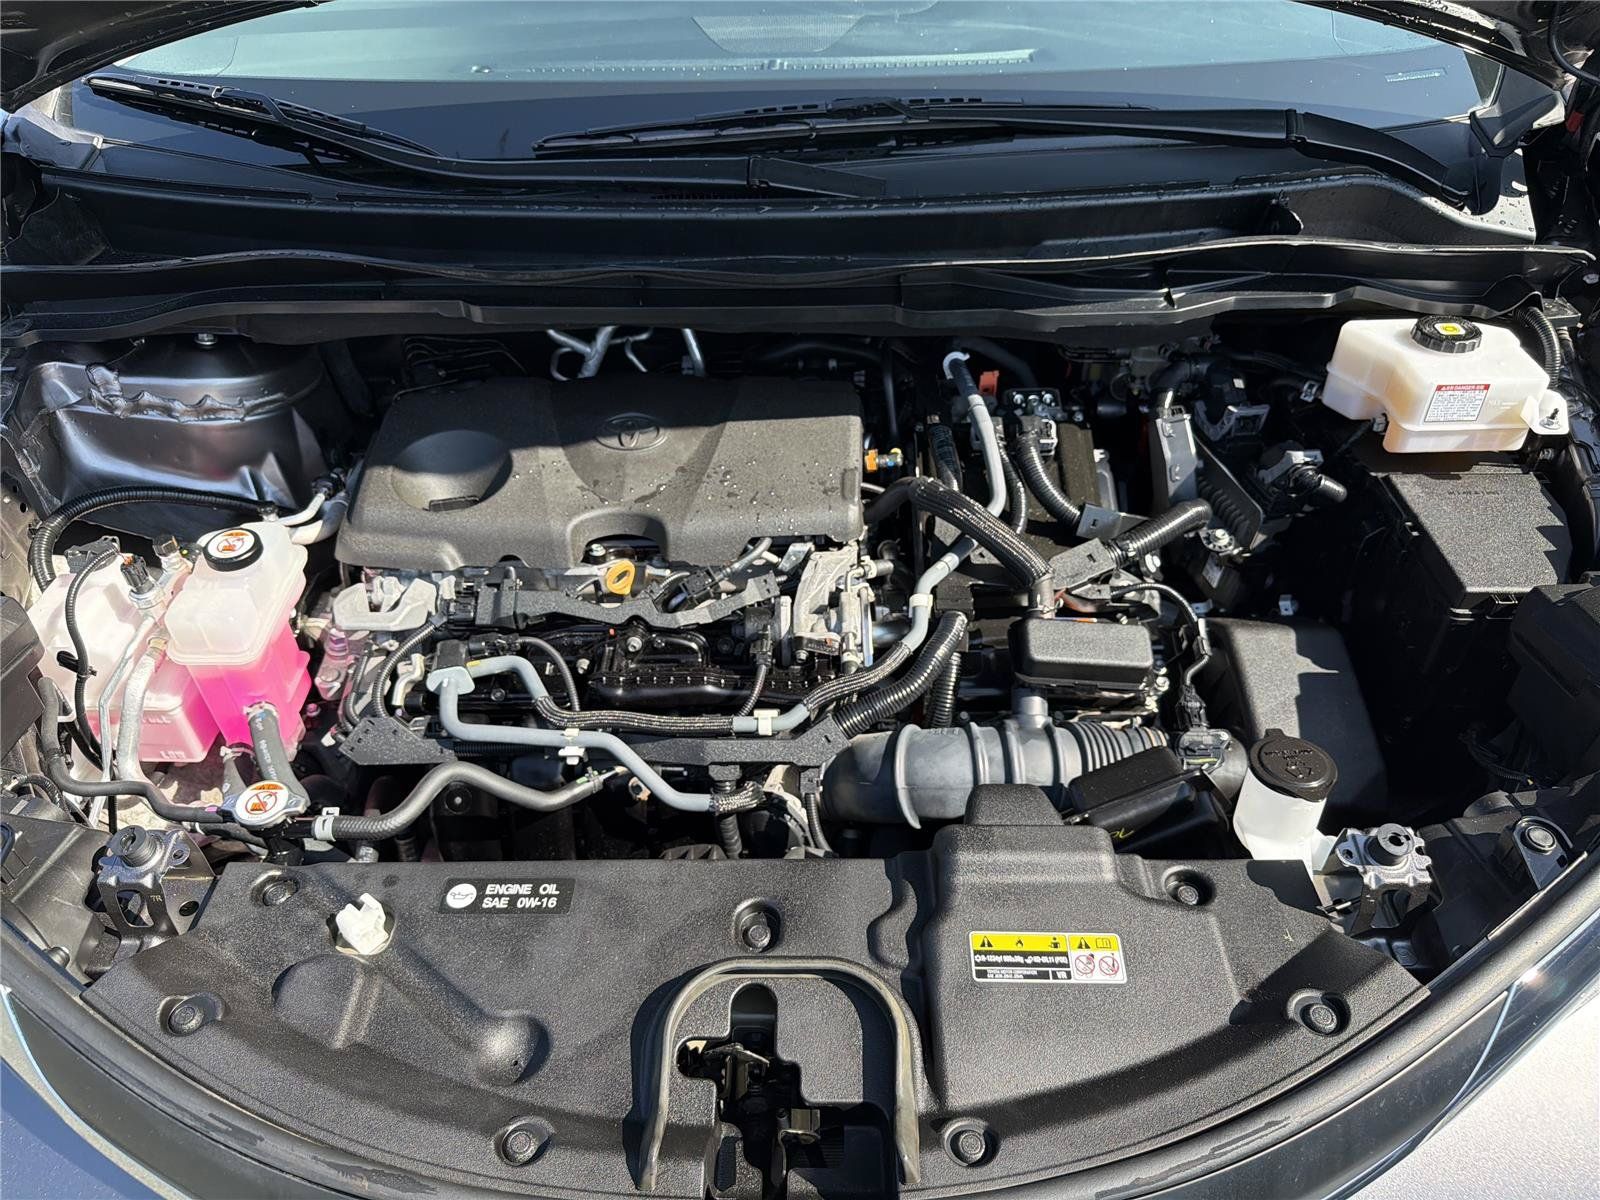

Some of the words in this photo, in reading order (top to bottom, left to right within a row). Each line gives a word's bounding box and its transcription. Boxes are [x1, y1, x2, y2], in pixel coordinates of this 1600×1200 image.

[485, 883, 533, 895] ENGINE
[539, 883, 560, 895] OIL
[482, 897, 510, 909] SAE
[516, 897, 558, 909] 0W-16
